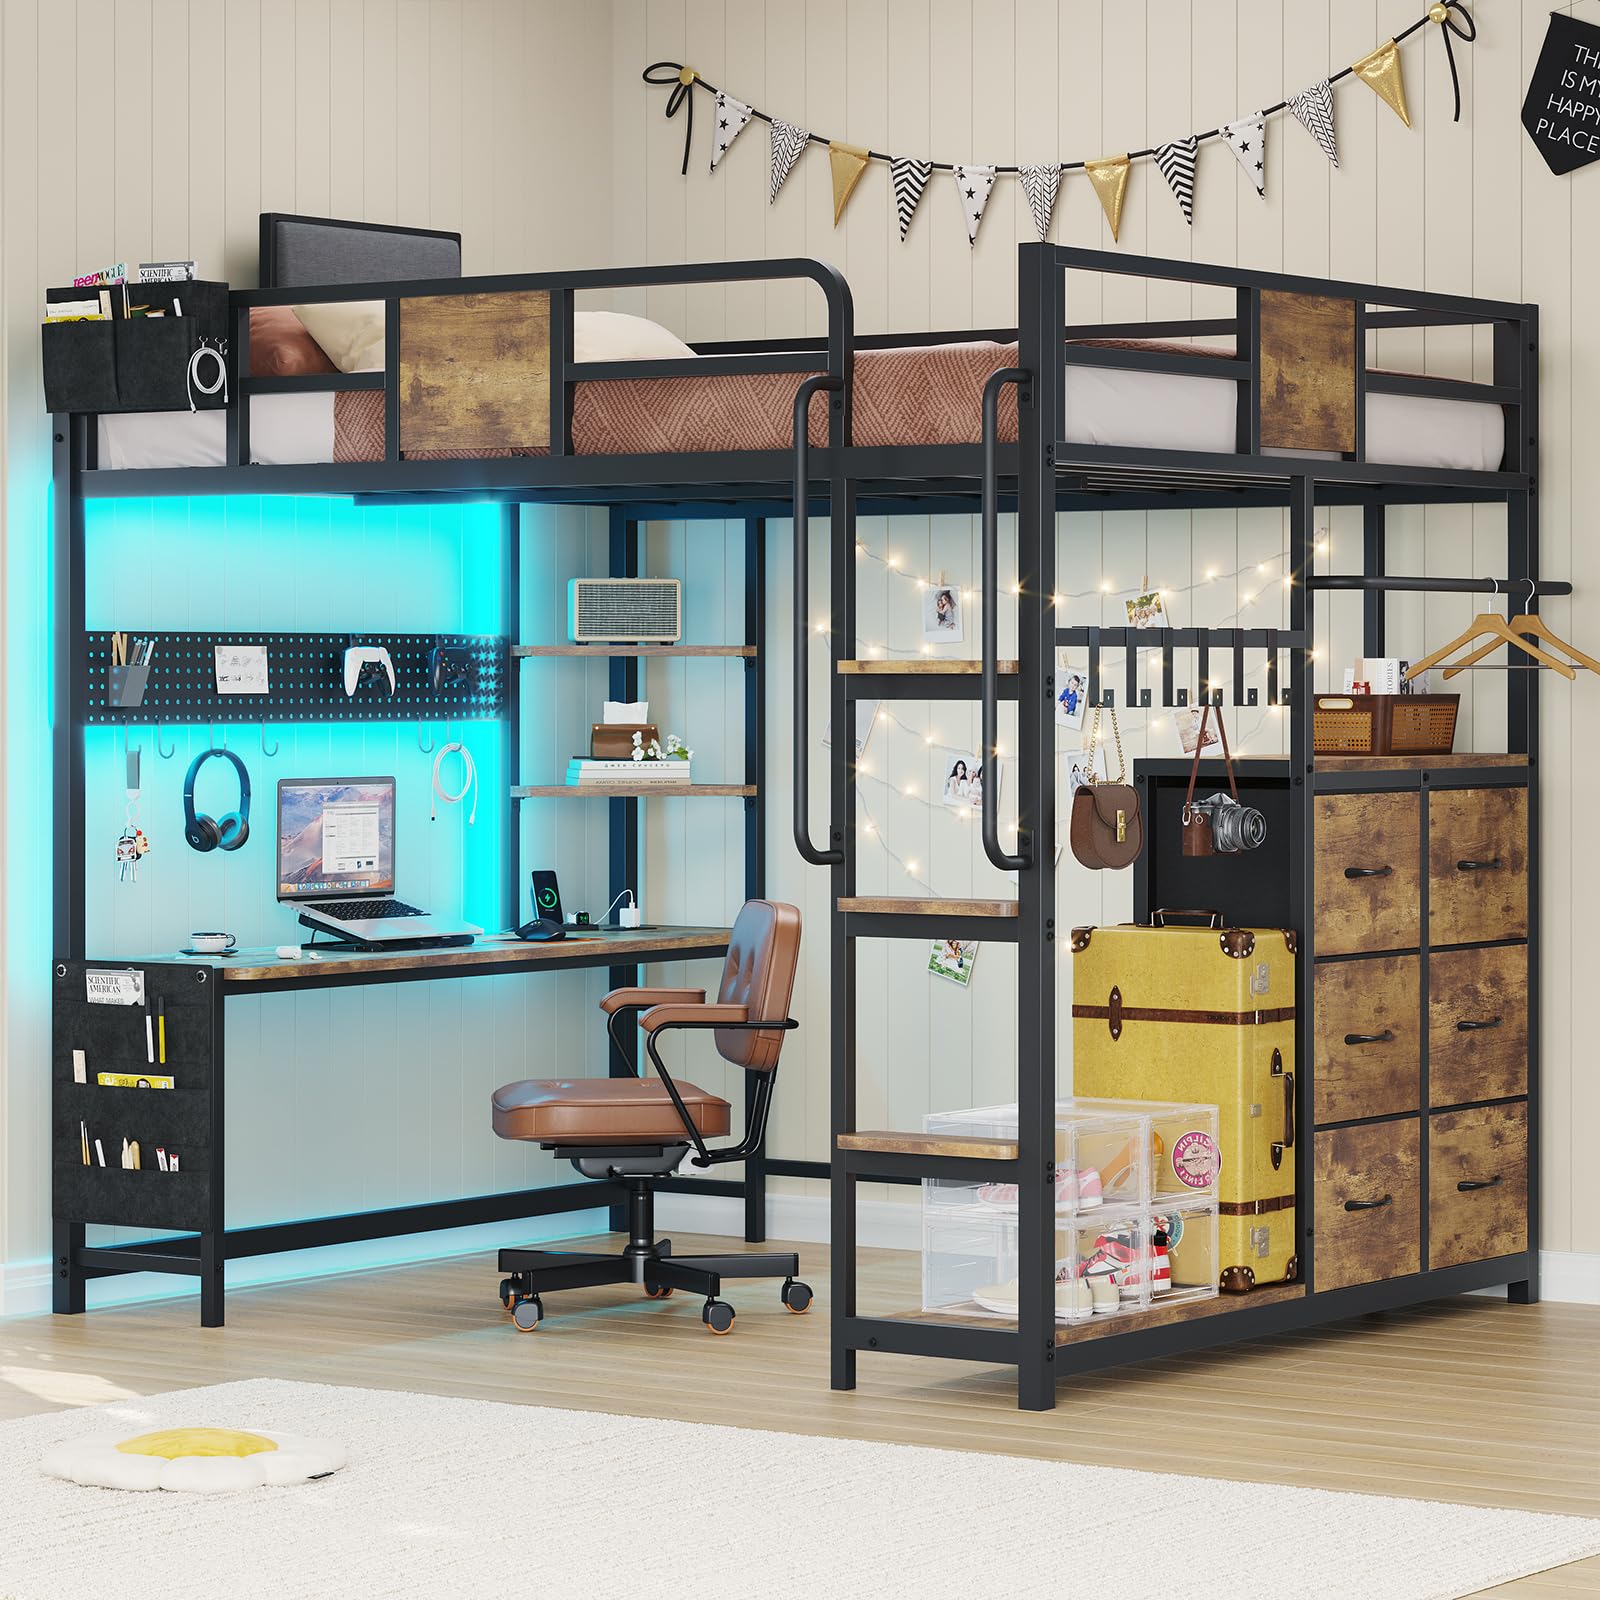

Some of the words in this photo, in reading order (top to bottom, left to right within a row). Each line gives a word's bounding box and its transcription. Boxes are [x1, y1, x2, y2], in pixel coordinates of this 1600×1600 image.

[1560, 69, 1578, 89] IS
[1546, 92, 1600, 126] HAPPY
[1535, 117, 1600, 154] PLACE
[140, 268, 174, 279] SCIENTIFIC
[88, 976, 120, 985] SCIENTIFIC
[89, 985, 121, 993] AMERICAN
